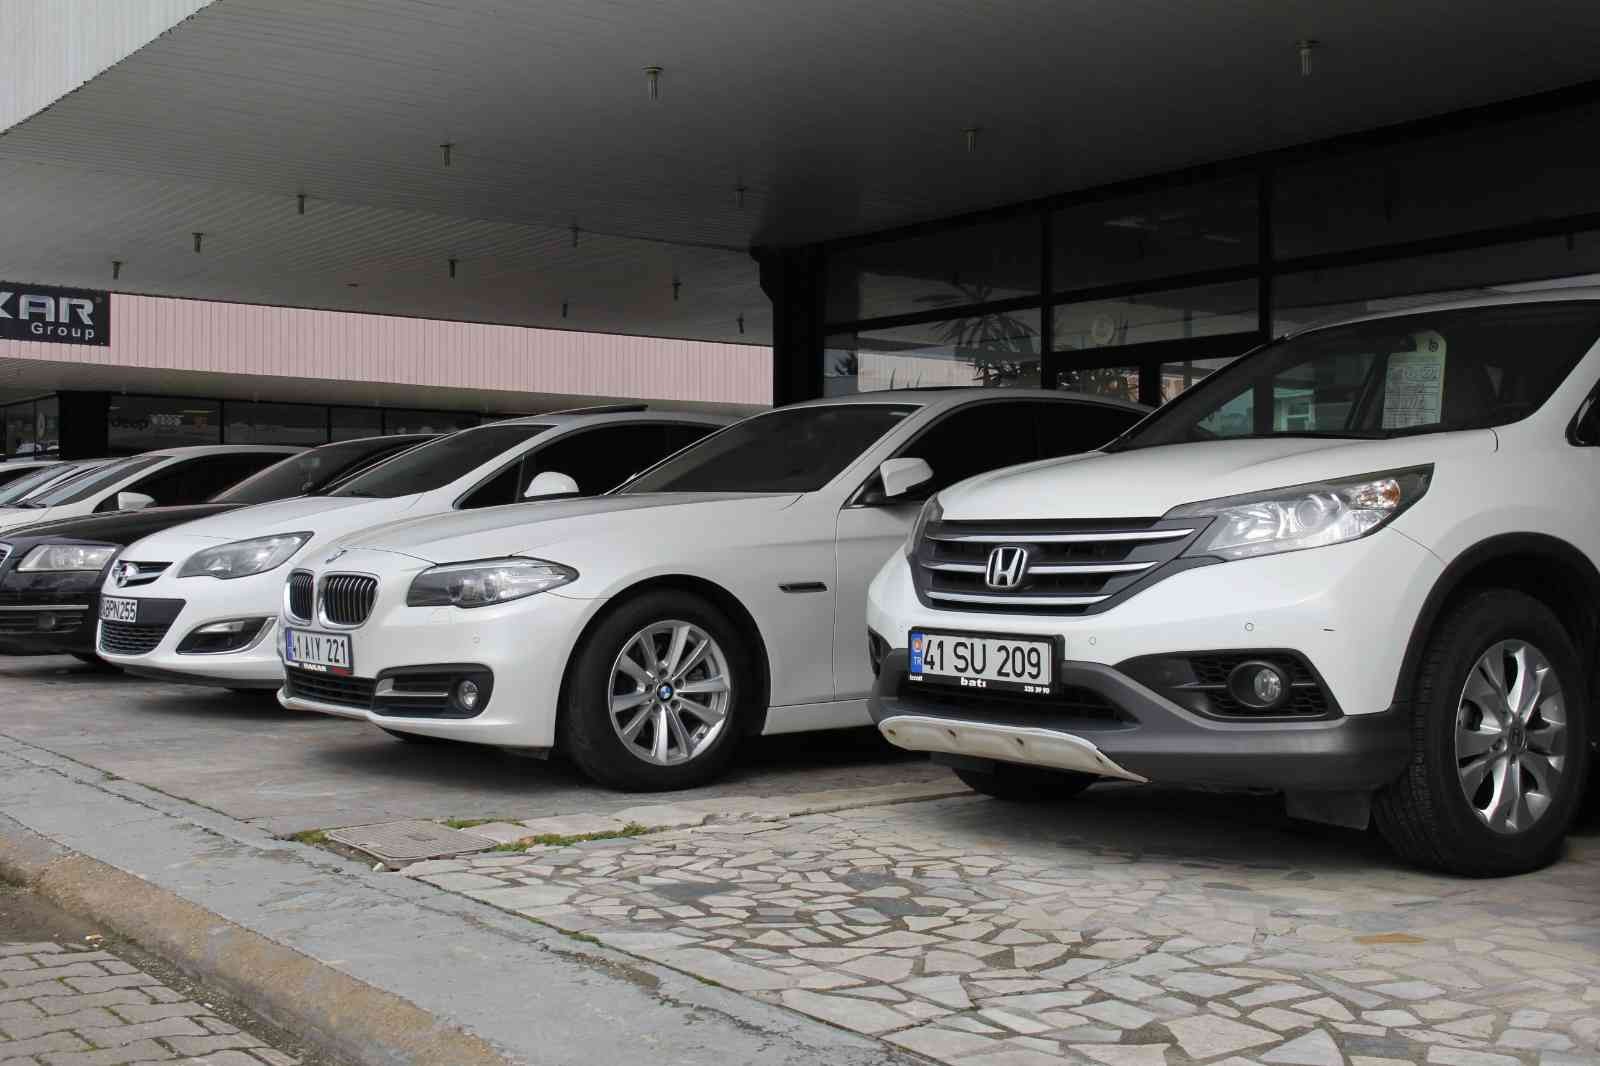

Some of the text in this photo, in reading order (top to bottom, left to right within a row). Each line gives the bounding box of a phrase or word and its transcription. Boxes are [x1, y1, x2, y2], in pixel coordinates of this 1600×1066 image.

[31, 322, 95, 341] Group
[326, 638, 346, 664] 221
[912, 639, 1041, 680] TR 41 SU 209
